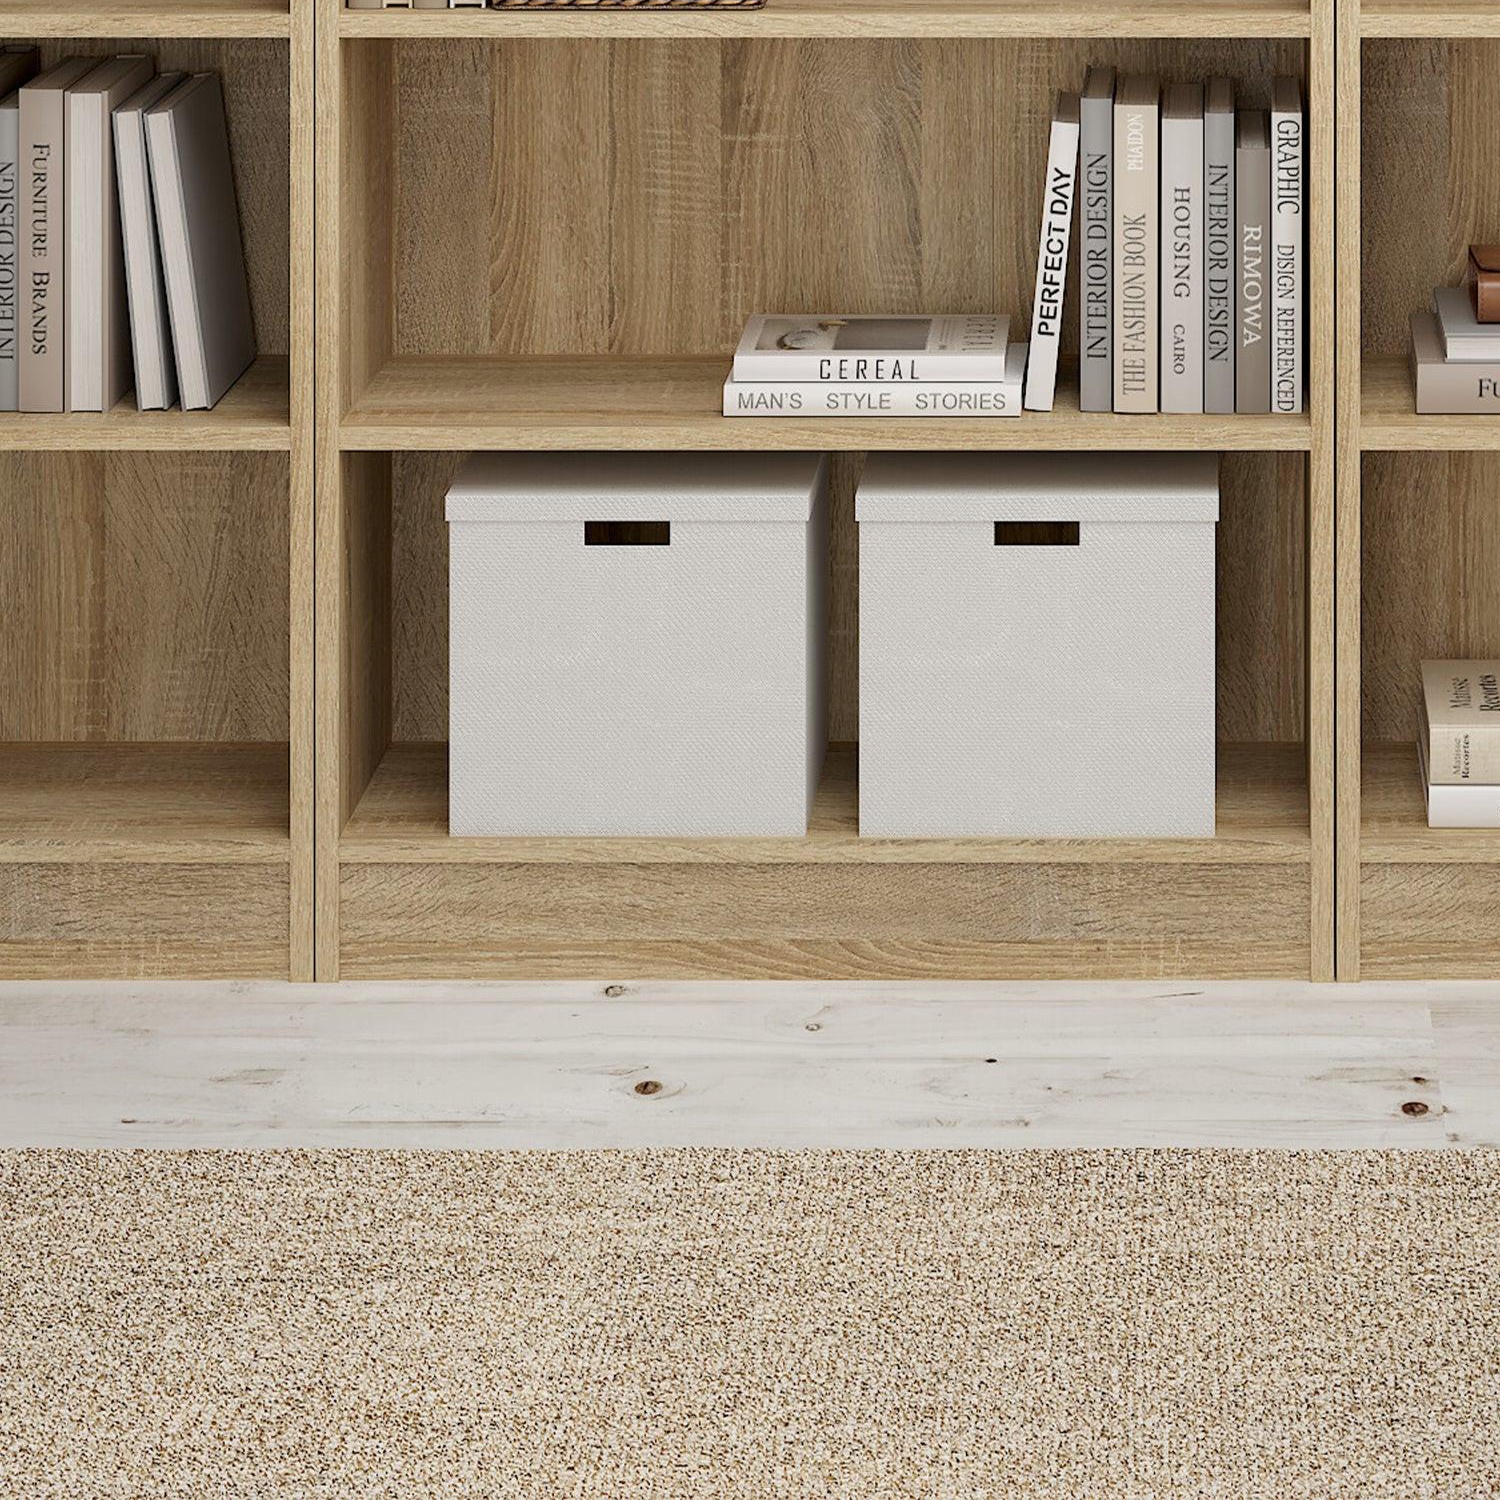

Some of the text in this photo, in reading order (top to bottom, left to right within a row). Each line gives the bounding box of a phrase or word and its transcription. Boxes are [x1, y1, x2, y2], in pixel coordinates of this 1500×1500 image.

[1127, 114, 1143, 170] PHAIDON
[1277, 120, 1299, 214] GRAPHIC
[0, 163, 14, 359] INTERIOR DESIGN
[32, 145, 50, 354] FURNITURE BRANDS
[1038, 167, 1071, 336] PERFECT DAY
[1087, 154, 1107, 358] INTERIOR DESIGN
[1123, 214, 1145, 395] THE FASHION BOOK
[1174, 188, 1190, 297] HOUSING
[1209, 165, 1228, 361] INTERIOR DESIGN
[1243, 225, 1262, 347] RIMOWA
[820, 359, 919, 379] CEREAL
[827, 393, 891, 409] STYLE
[916, 393, 1005, 410] STORIES
[1174, 324, 1185, 374] CAIRO
[1276, 245, 1295, 413] DISIGN REFERENCED
